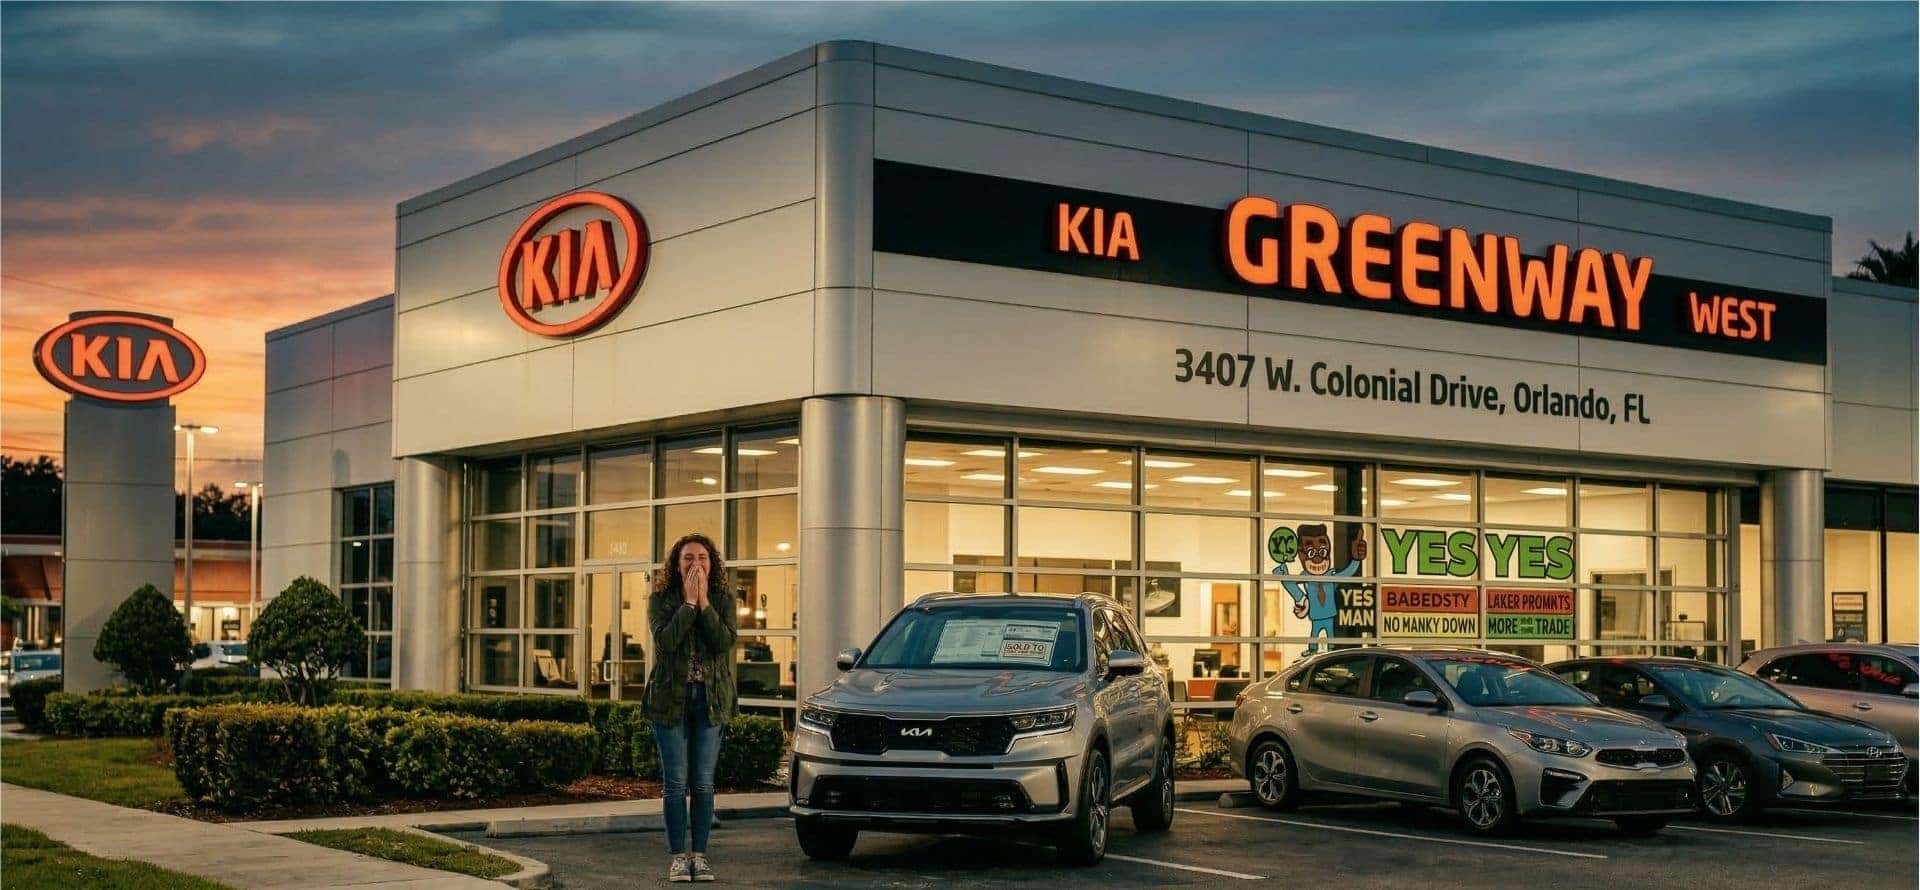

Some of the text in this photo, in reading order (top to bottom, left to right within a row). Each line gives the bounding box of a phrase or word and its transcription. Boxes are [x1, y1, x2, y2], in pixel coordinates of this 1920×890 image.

[521, 218, 621, 313] KIA
[1057, 195, 1776, 342] KIA GREENWAY WEST
[70, 333, 180, 384] KIA
[1175, 348, 1651, 425] 3407 W. Colonial Drive, Orlando, FL
[1381, 528, 1575, 580] YES YES
[1341, 588, 1374, 607] YES
[1386, 592, 1471, 608] BABEDSTY
[1487, 593, 1520, 609] LAKER
[1338, 609, 1375, 626] MAN
[1383, 616, 1476, 634] NO MANKY DOWN
[1488, 617, 1518, 634] MORE
[1535, 618, 1570, 635] TRADE
